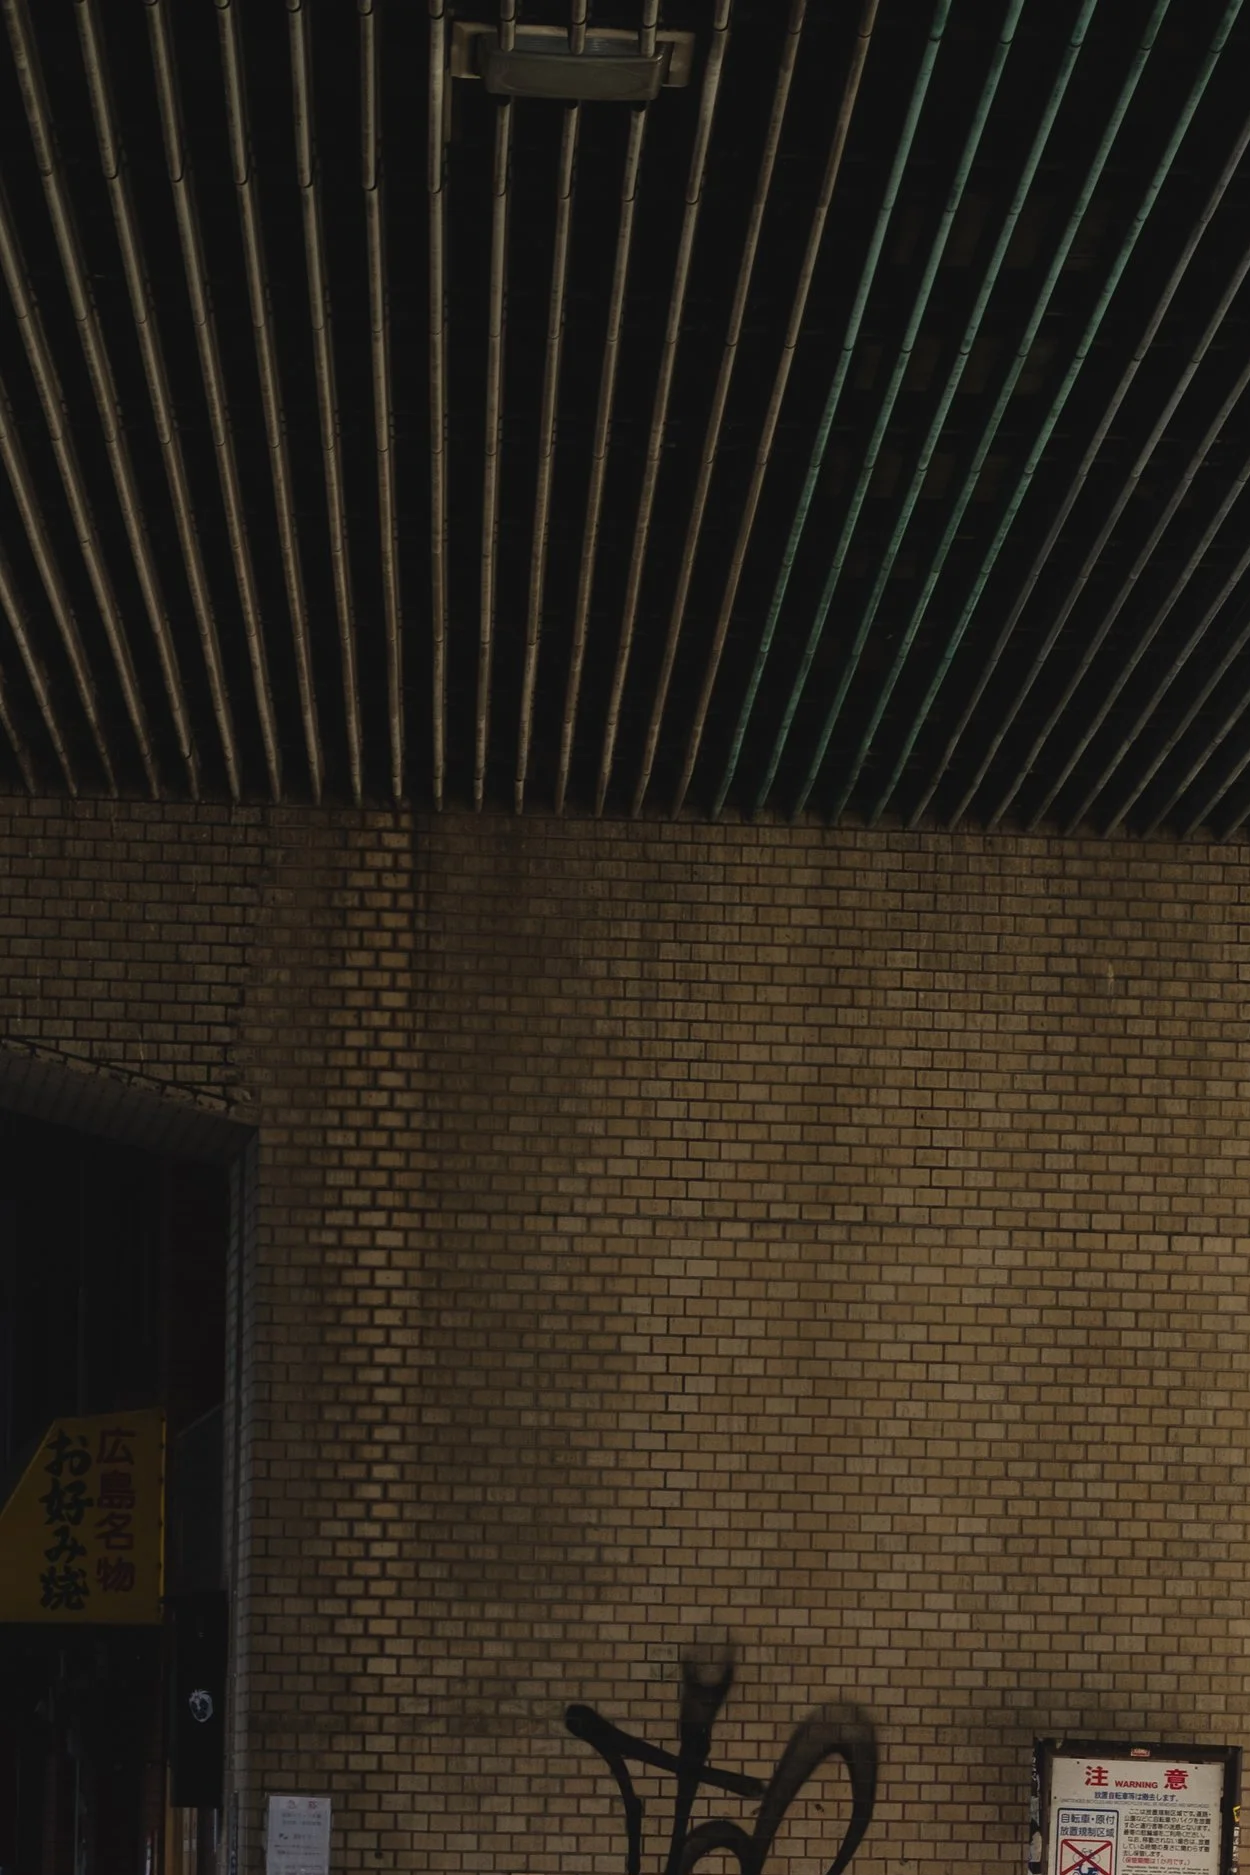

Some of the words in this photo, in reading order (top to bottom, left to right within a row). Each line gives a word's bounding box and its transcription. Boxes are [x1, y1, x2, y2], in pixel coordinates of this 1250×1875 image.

[94, 1426, 137, 1593] 広島名物
[1085, 1765, 1109, 1787] 注
[1164, 1769, 1189, 1790] 意
[1115, 1780, 1158, 1789] WARNING
[1061, 1813, 1115, 1825] 自転車・原付
[1060, 1826, 1115, 1838] 放置規制区域
